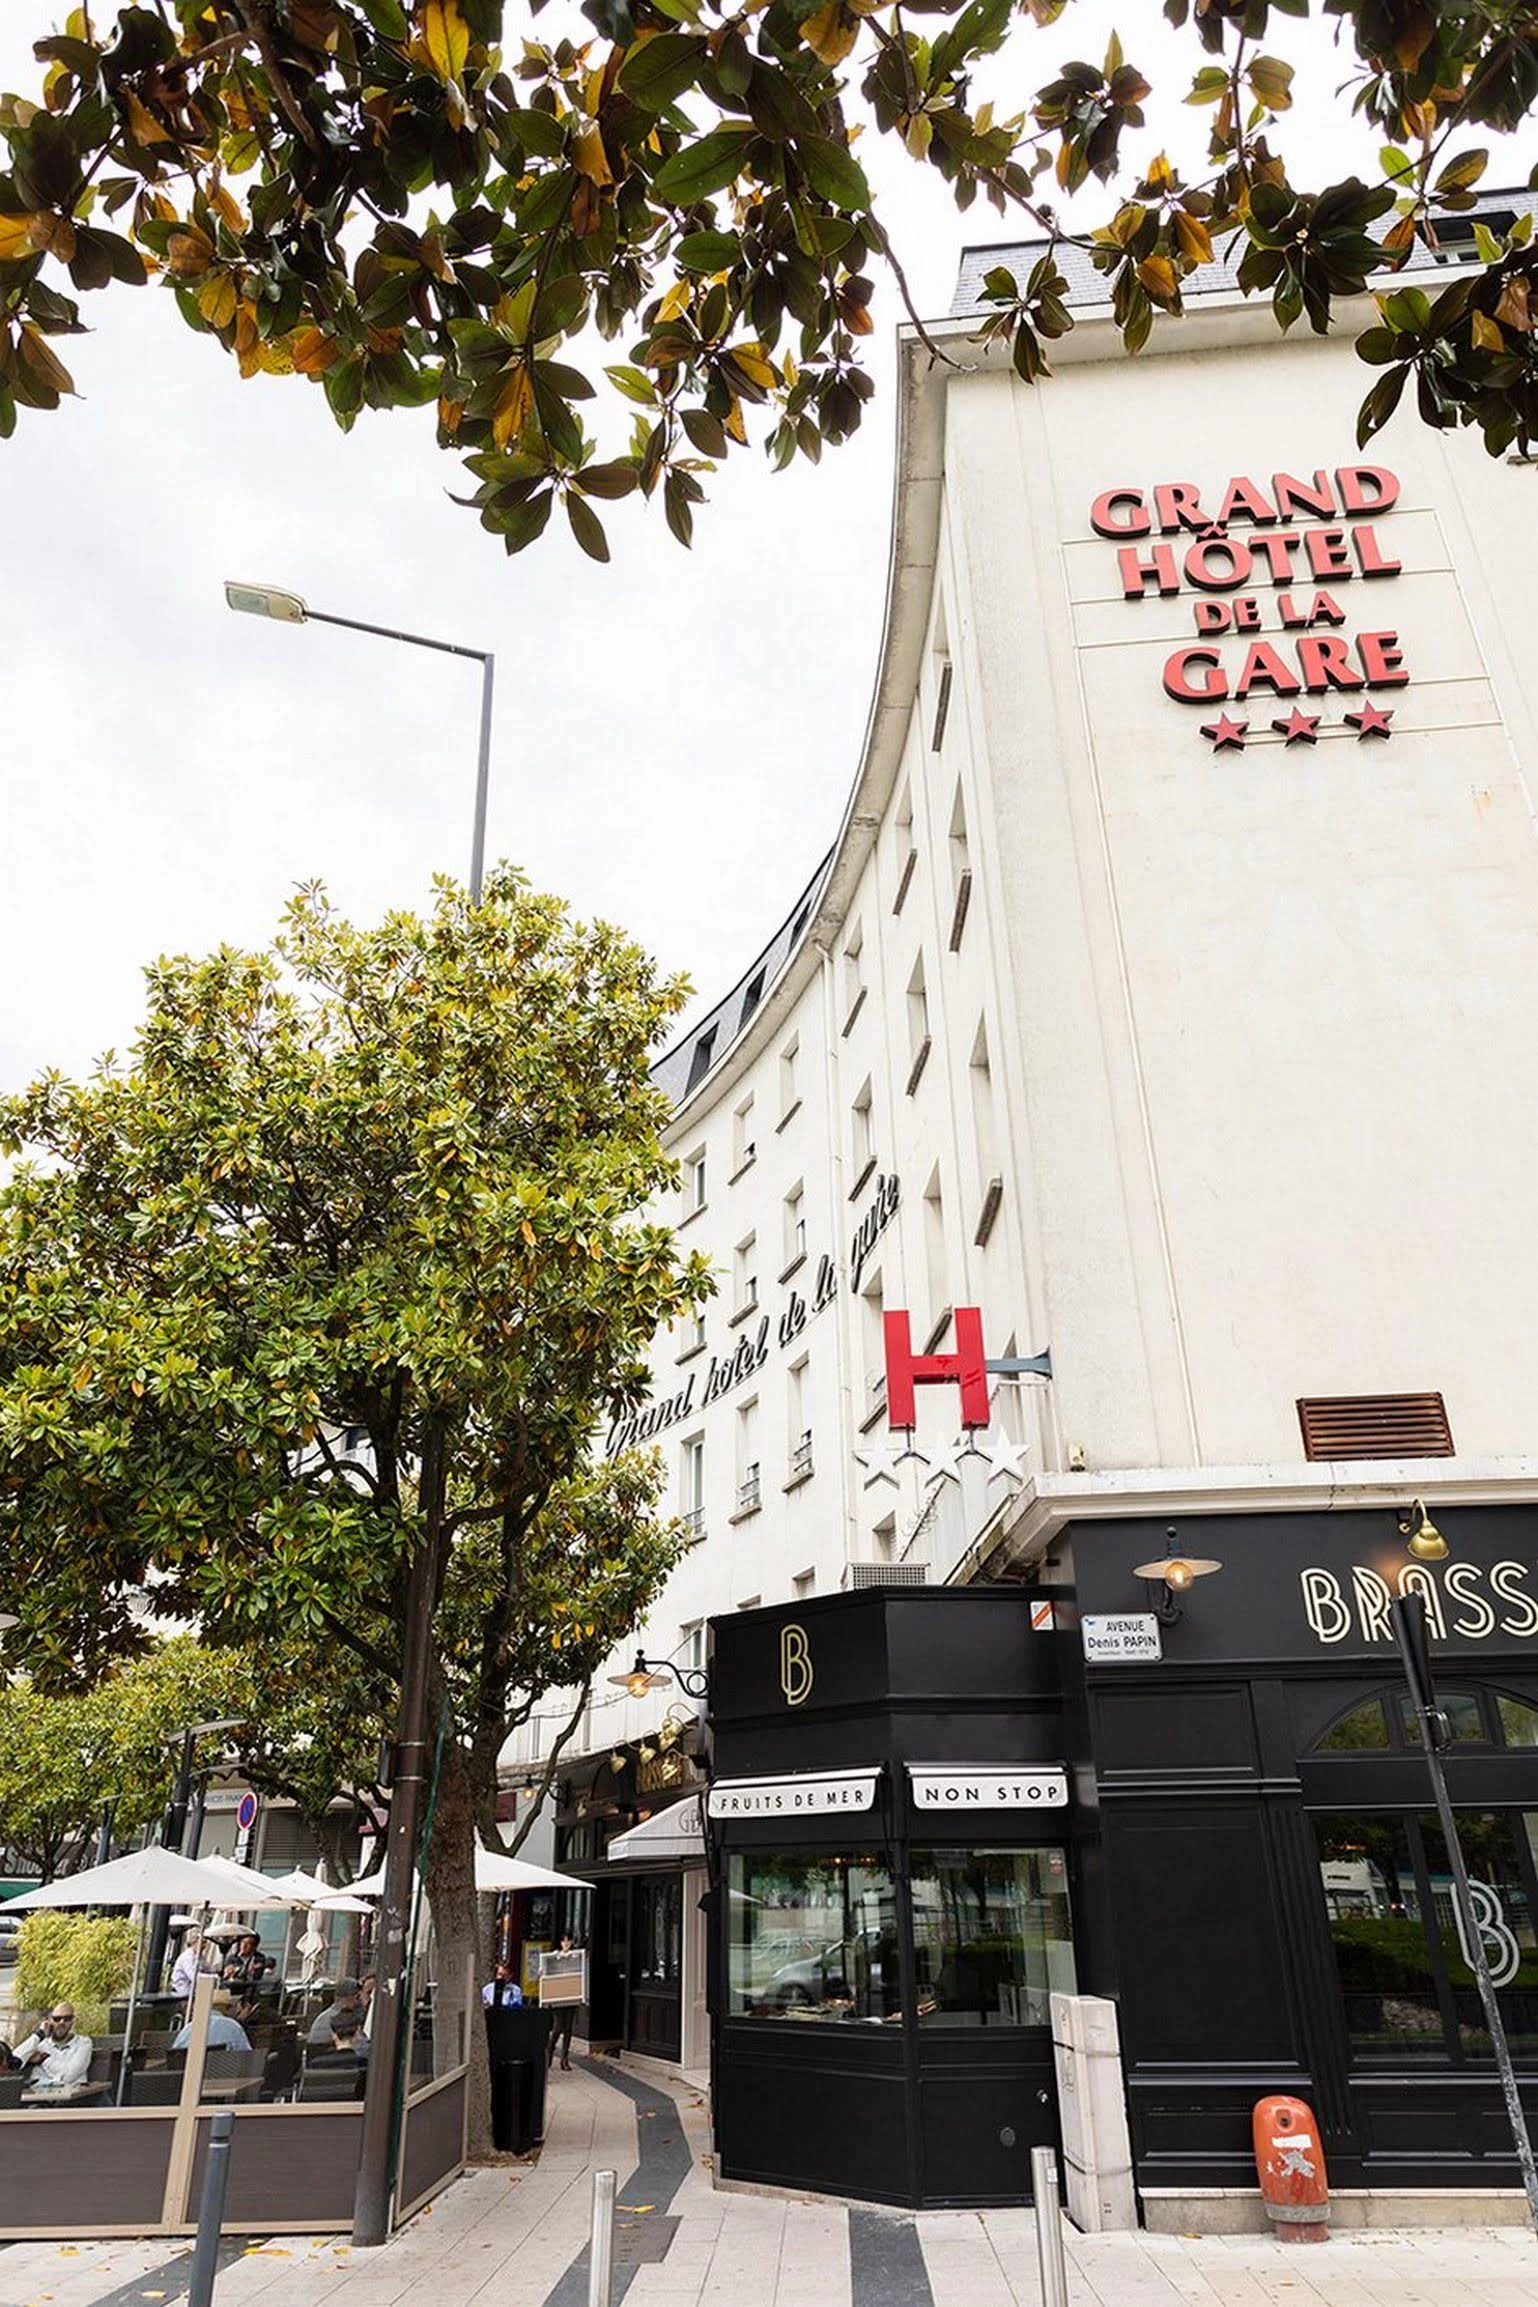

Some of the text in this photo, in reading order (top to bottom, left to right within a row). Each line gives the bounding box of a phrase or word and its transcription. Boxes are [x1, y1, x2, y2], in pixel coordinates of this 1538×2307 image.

[1091, 465, 1400, 539] GRAND
[1117, 525, 1402, 600] HÔTEL
[1194, 590, 1346, 637] DE LA
[1162, 630, 1410, 704] GARE
[779, 1291, 806, 1349] de
[811, 1254, 838, 1314] la
[883, 1307, 991, 1433] H
[1106, 1620, 1145, 1633] AVENUE
[1301, 1561, 1538, 1643] BRASS
[780, 1624, 815, 1707] B
[1087, 1635, 1157, 1649] Denis PAPIN
[720, 1789, 864, 1811] FRUITS DE MER
[925, 1786, 1058, 1801] NON STOP
[1449, 1878, 1521, 1989] B
